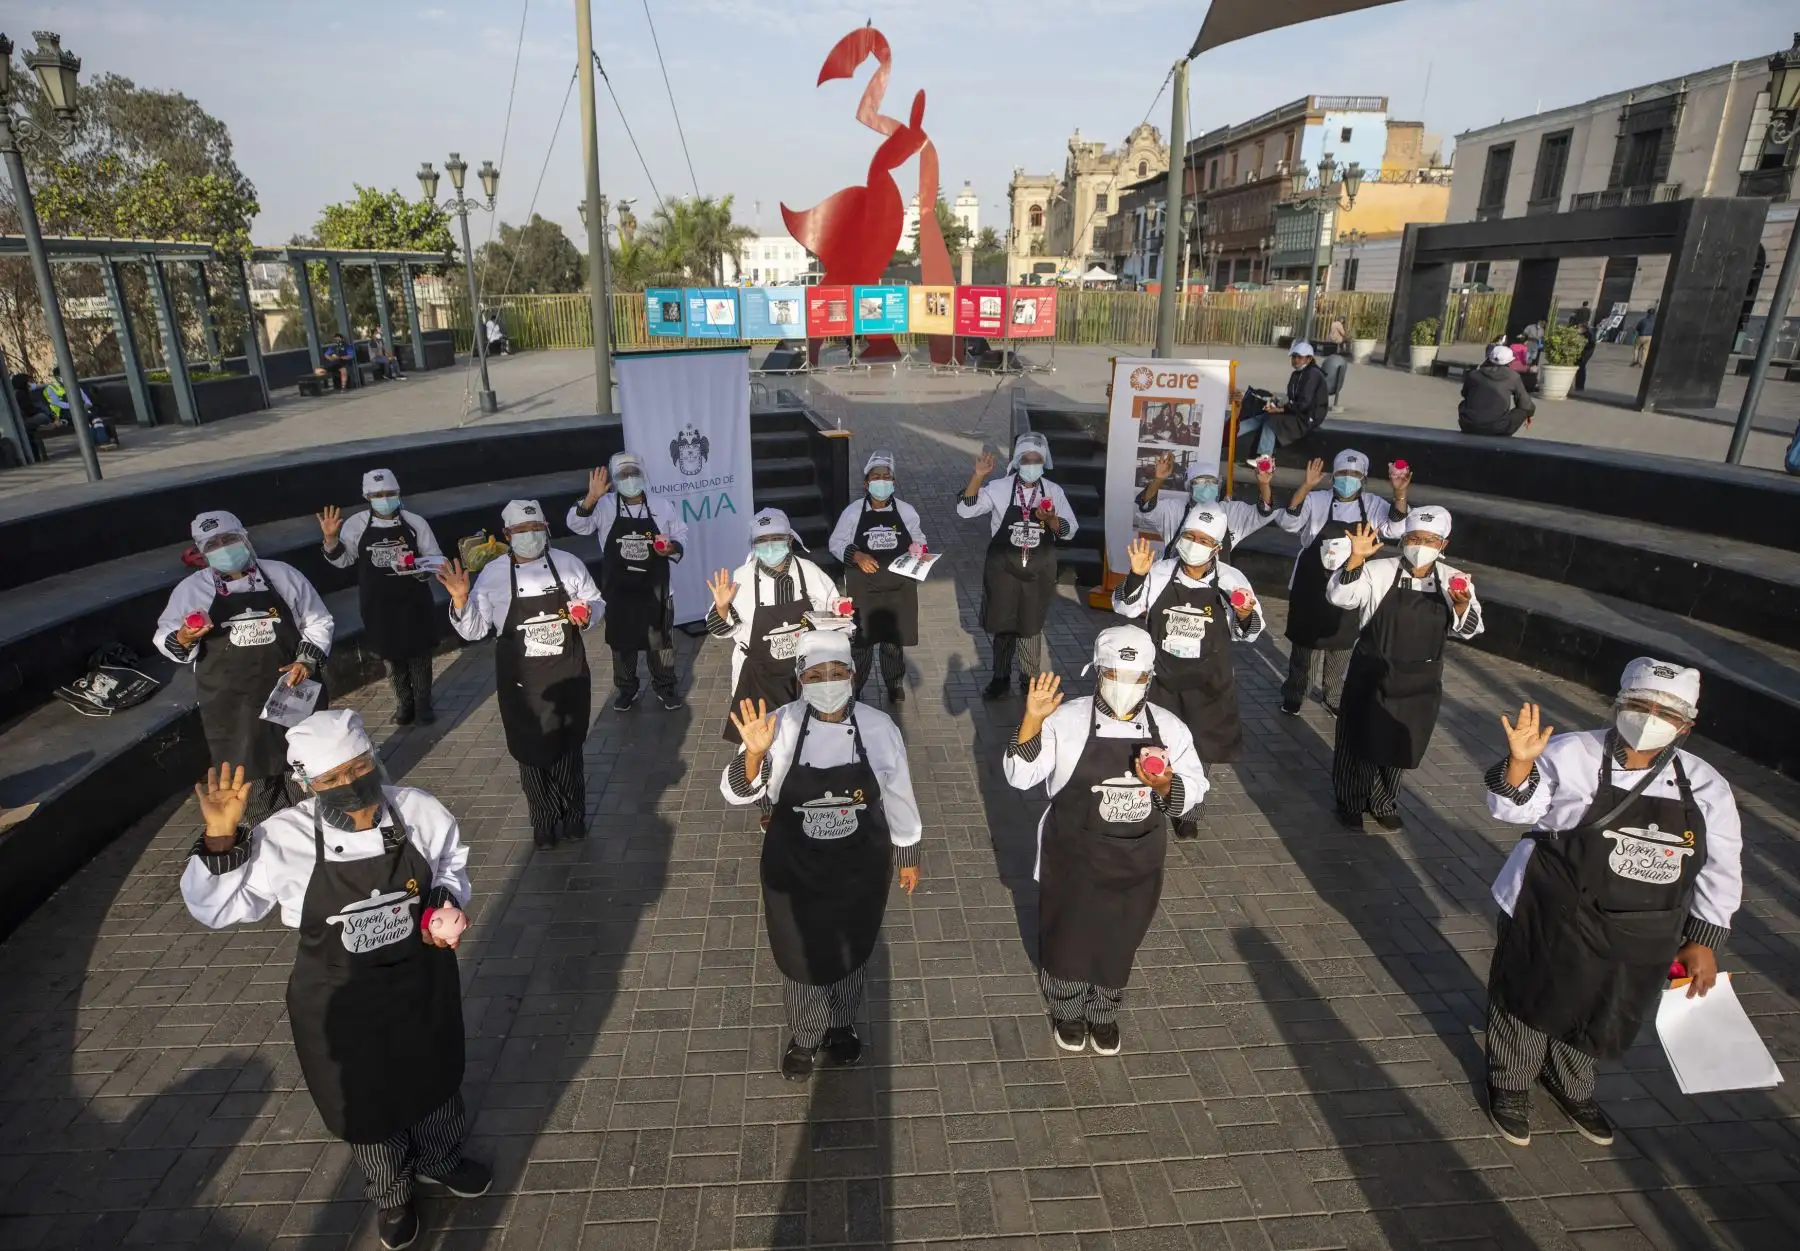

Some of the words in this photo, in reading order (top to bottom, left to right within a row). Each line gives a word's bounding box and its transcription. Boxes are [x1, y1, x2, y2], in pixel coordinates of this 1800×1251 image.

[1155, 372, 1199, 390] care
[723, 475, 735, 483] DE
[672, 492, 737, 523] MA
